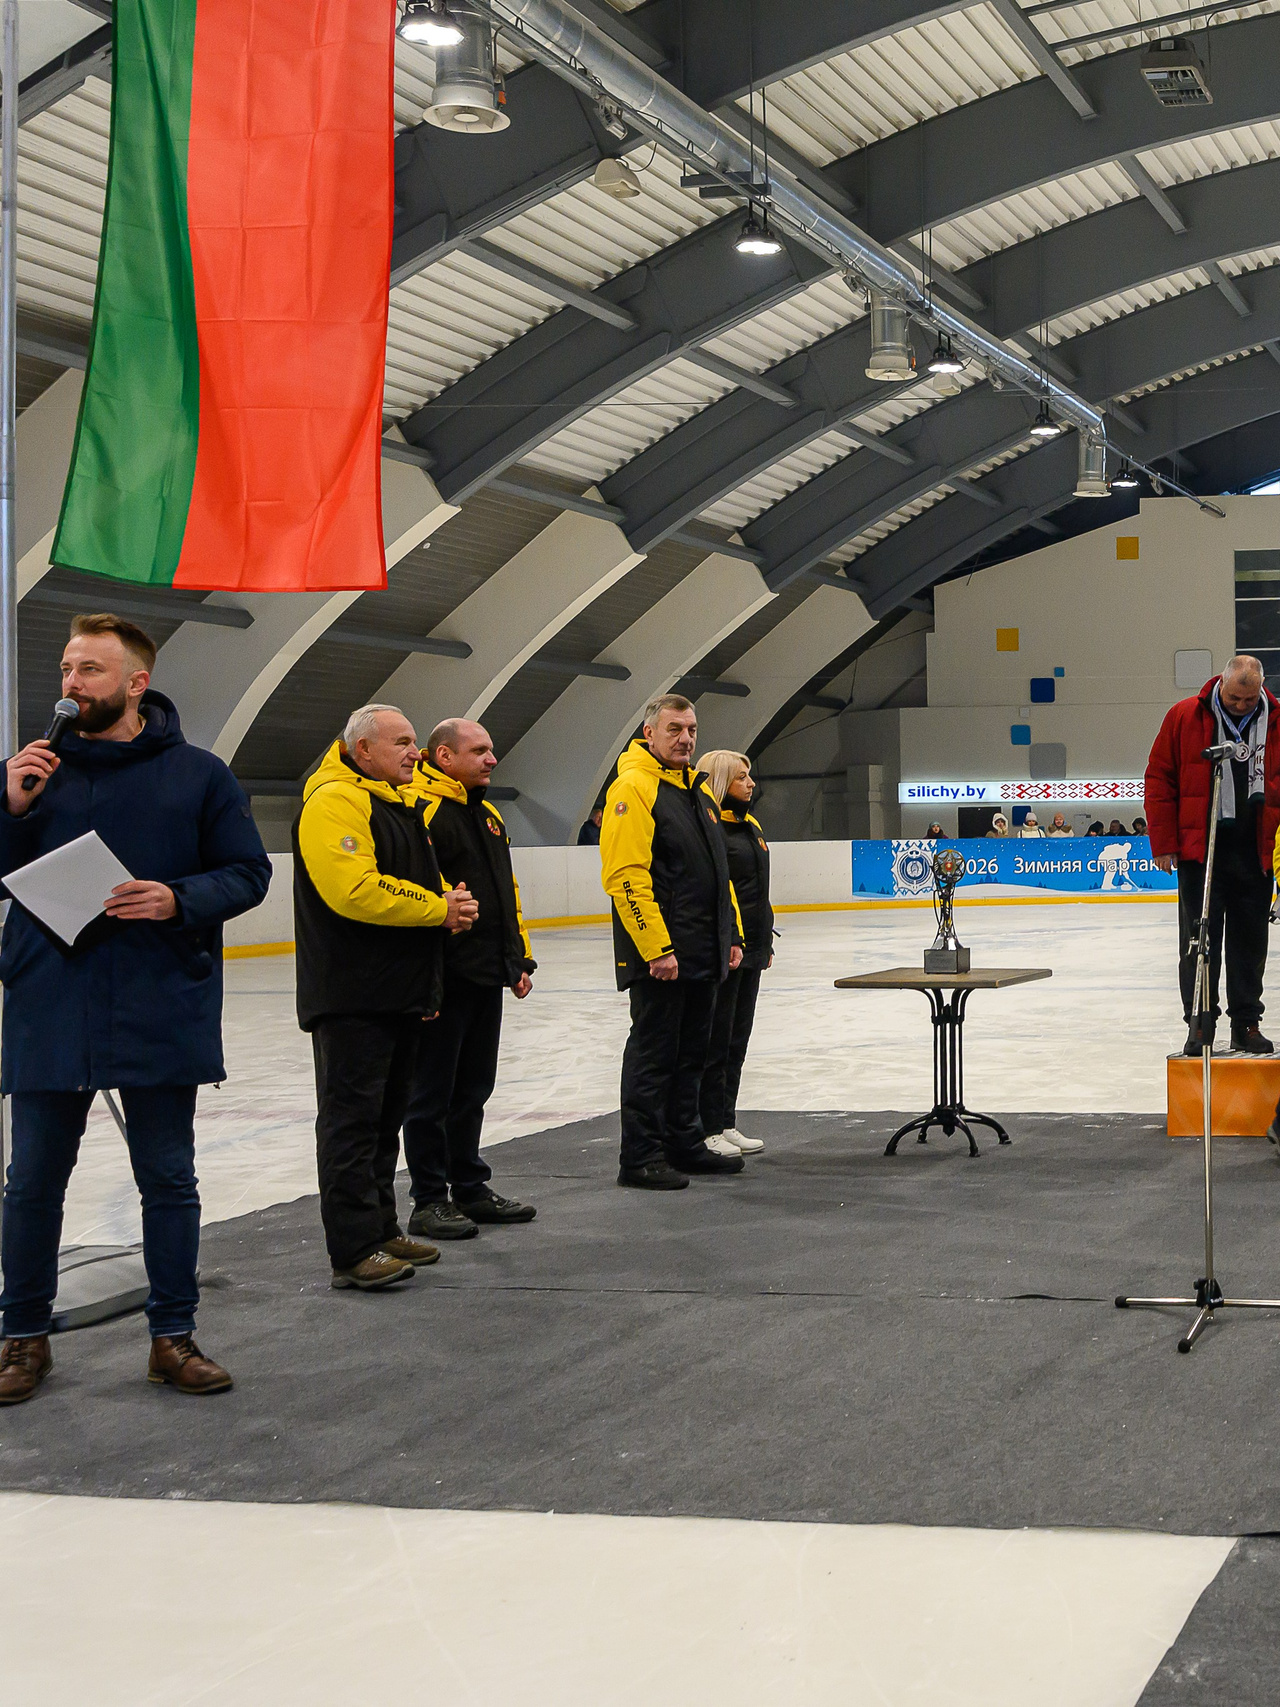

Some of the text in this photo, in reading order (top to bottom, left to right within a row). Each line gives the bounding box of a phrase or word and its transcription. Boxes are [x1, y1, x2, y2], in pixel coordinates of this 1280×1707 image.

[908, 785, 986, 799] silichy.by
[965, 858, 999, 875] 026
[1013, 857, 1082, 875] Зимняя
[1087, 858, 1178, 876] спартак
[622, 880, 648, 931] BELARUS
